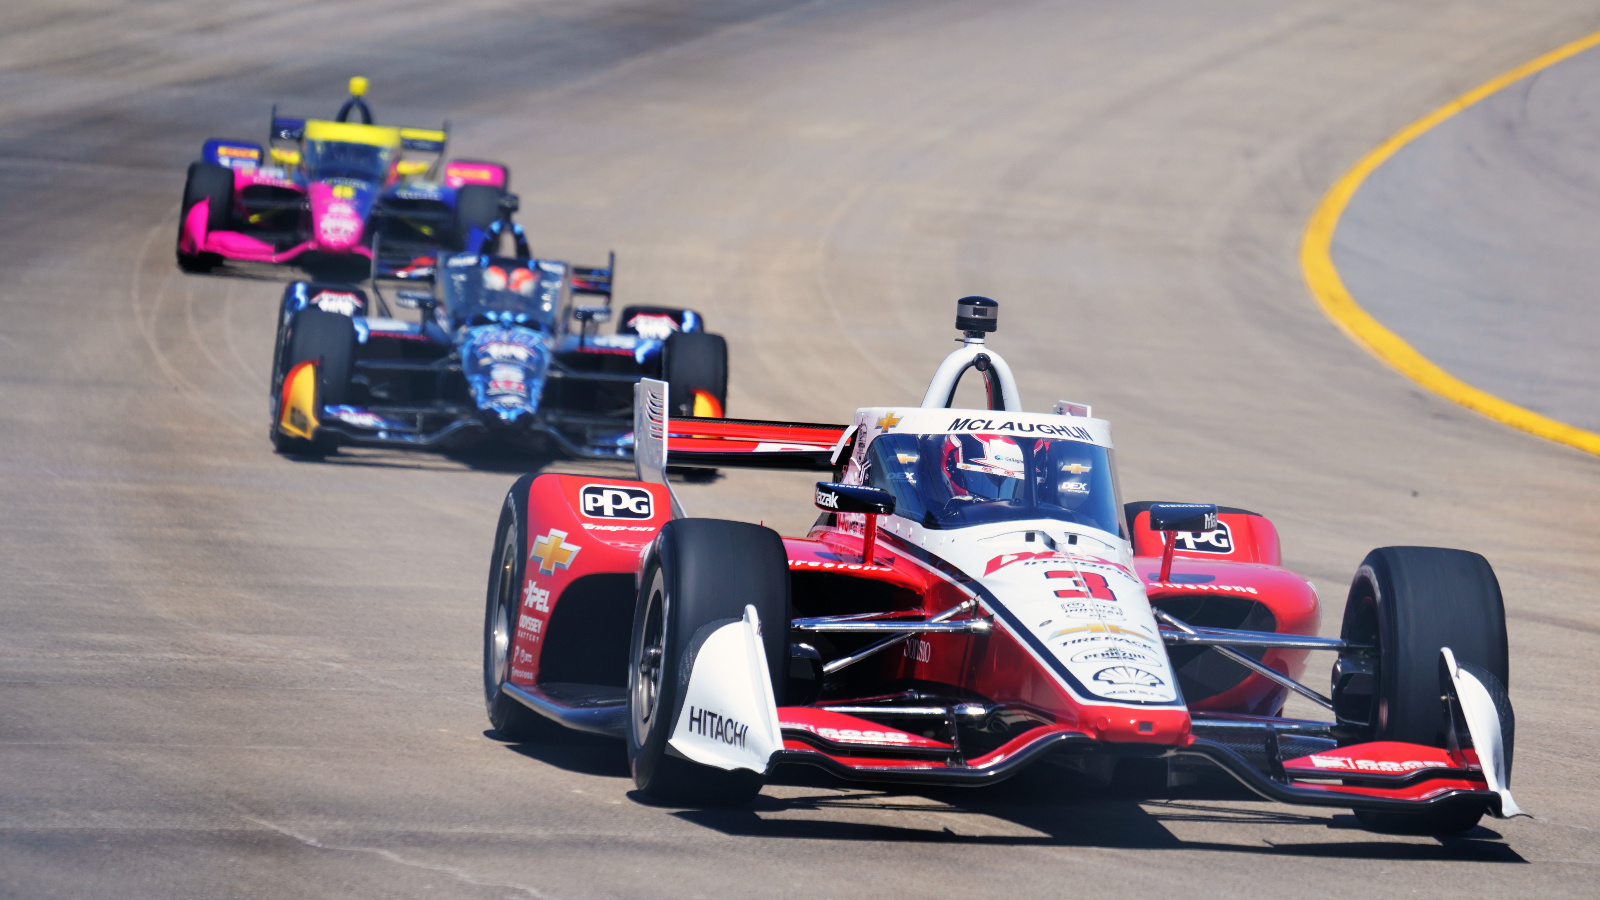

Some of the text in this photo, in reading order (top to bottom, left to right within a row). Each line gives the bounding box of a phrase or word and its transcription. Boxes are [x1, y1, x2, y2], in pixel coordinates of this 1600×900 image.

[948, 418, 1094, 442] MCLAUGHLIN
[1061, 481, 1087, 490] DEX
[584, 489, 649, 516] PPG
[524, 580, 550, 613] XPEL
[1044, 570, 1118, 601] 3
[1149, 582, 1258, 595] Firestone
[519, 614, 542, 634] ODYSSEY
[1059, 637, 1102, 647] TIRE
[689, 706, 749, 751] HITACHI
